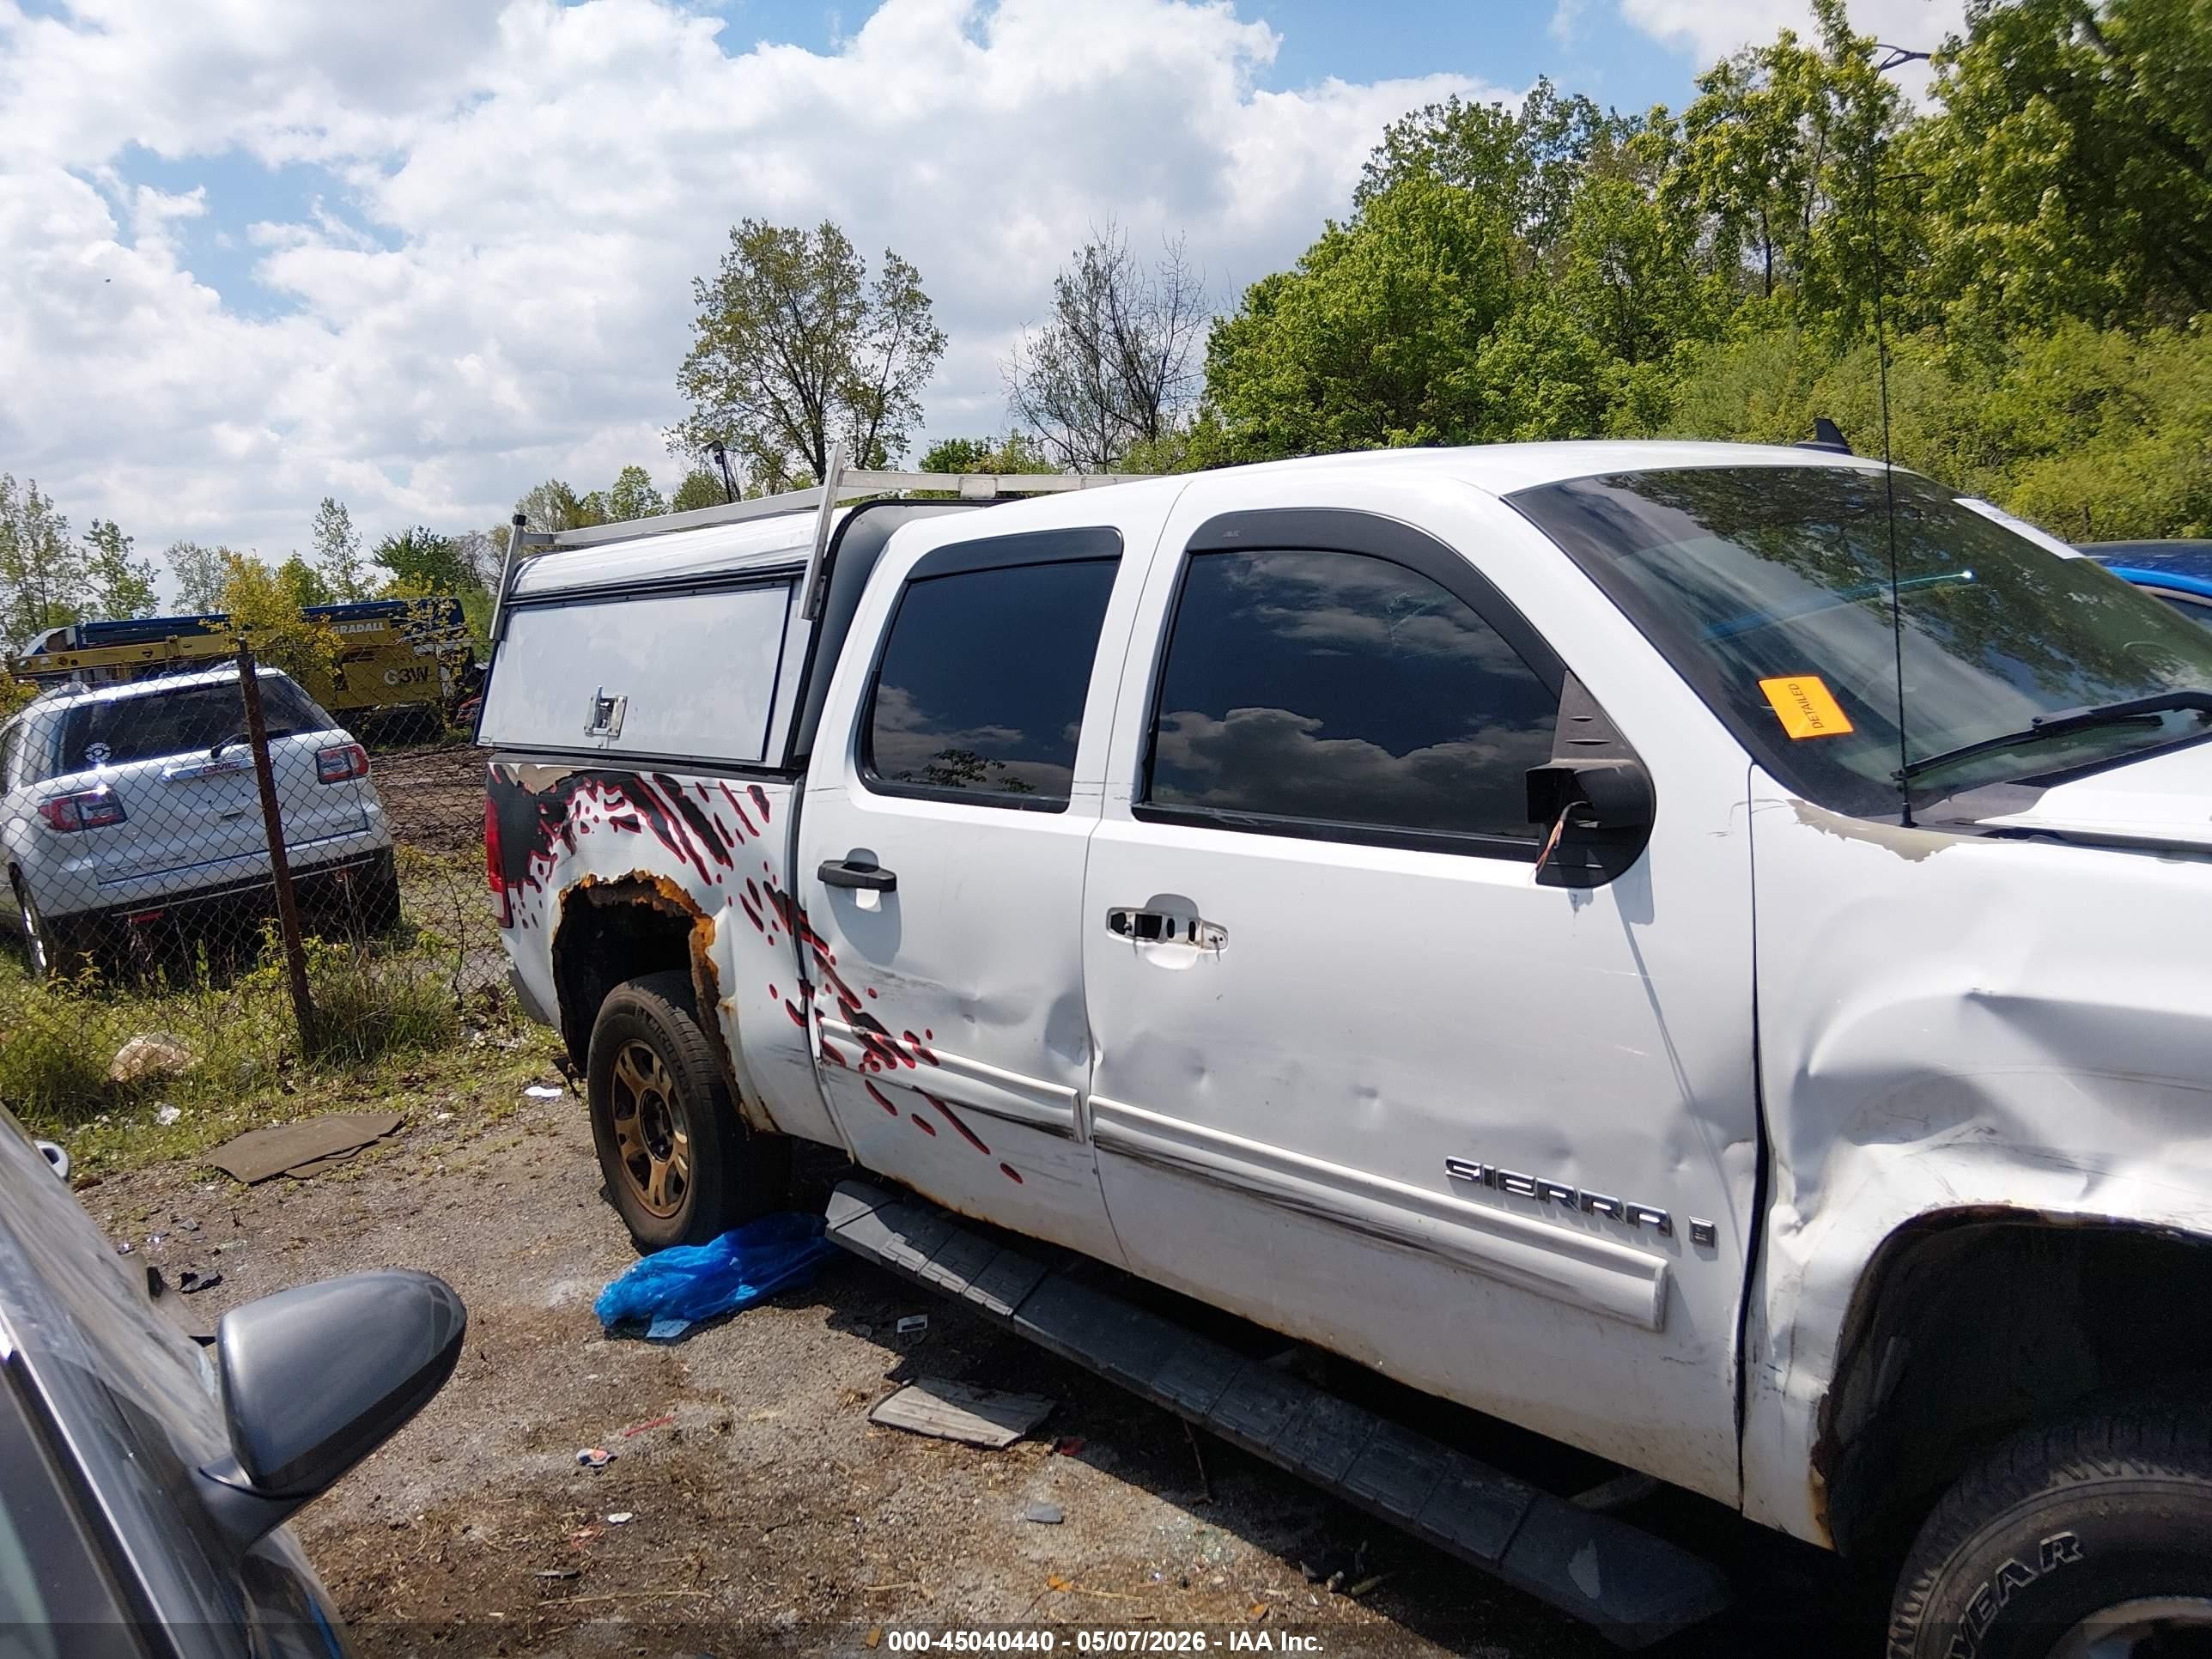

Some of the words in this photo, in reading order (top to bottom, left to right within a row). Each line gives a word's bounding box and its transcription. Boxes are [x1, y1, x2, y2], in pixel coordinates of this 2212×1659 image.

[331, 623, 385, 635] GRADALL
[1787, 683, 1825, 729] DETAILED
[1444, 1155, 1674, 1237] SIERRA
